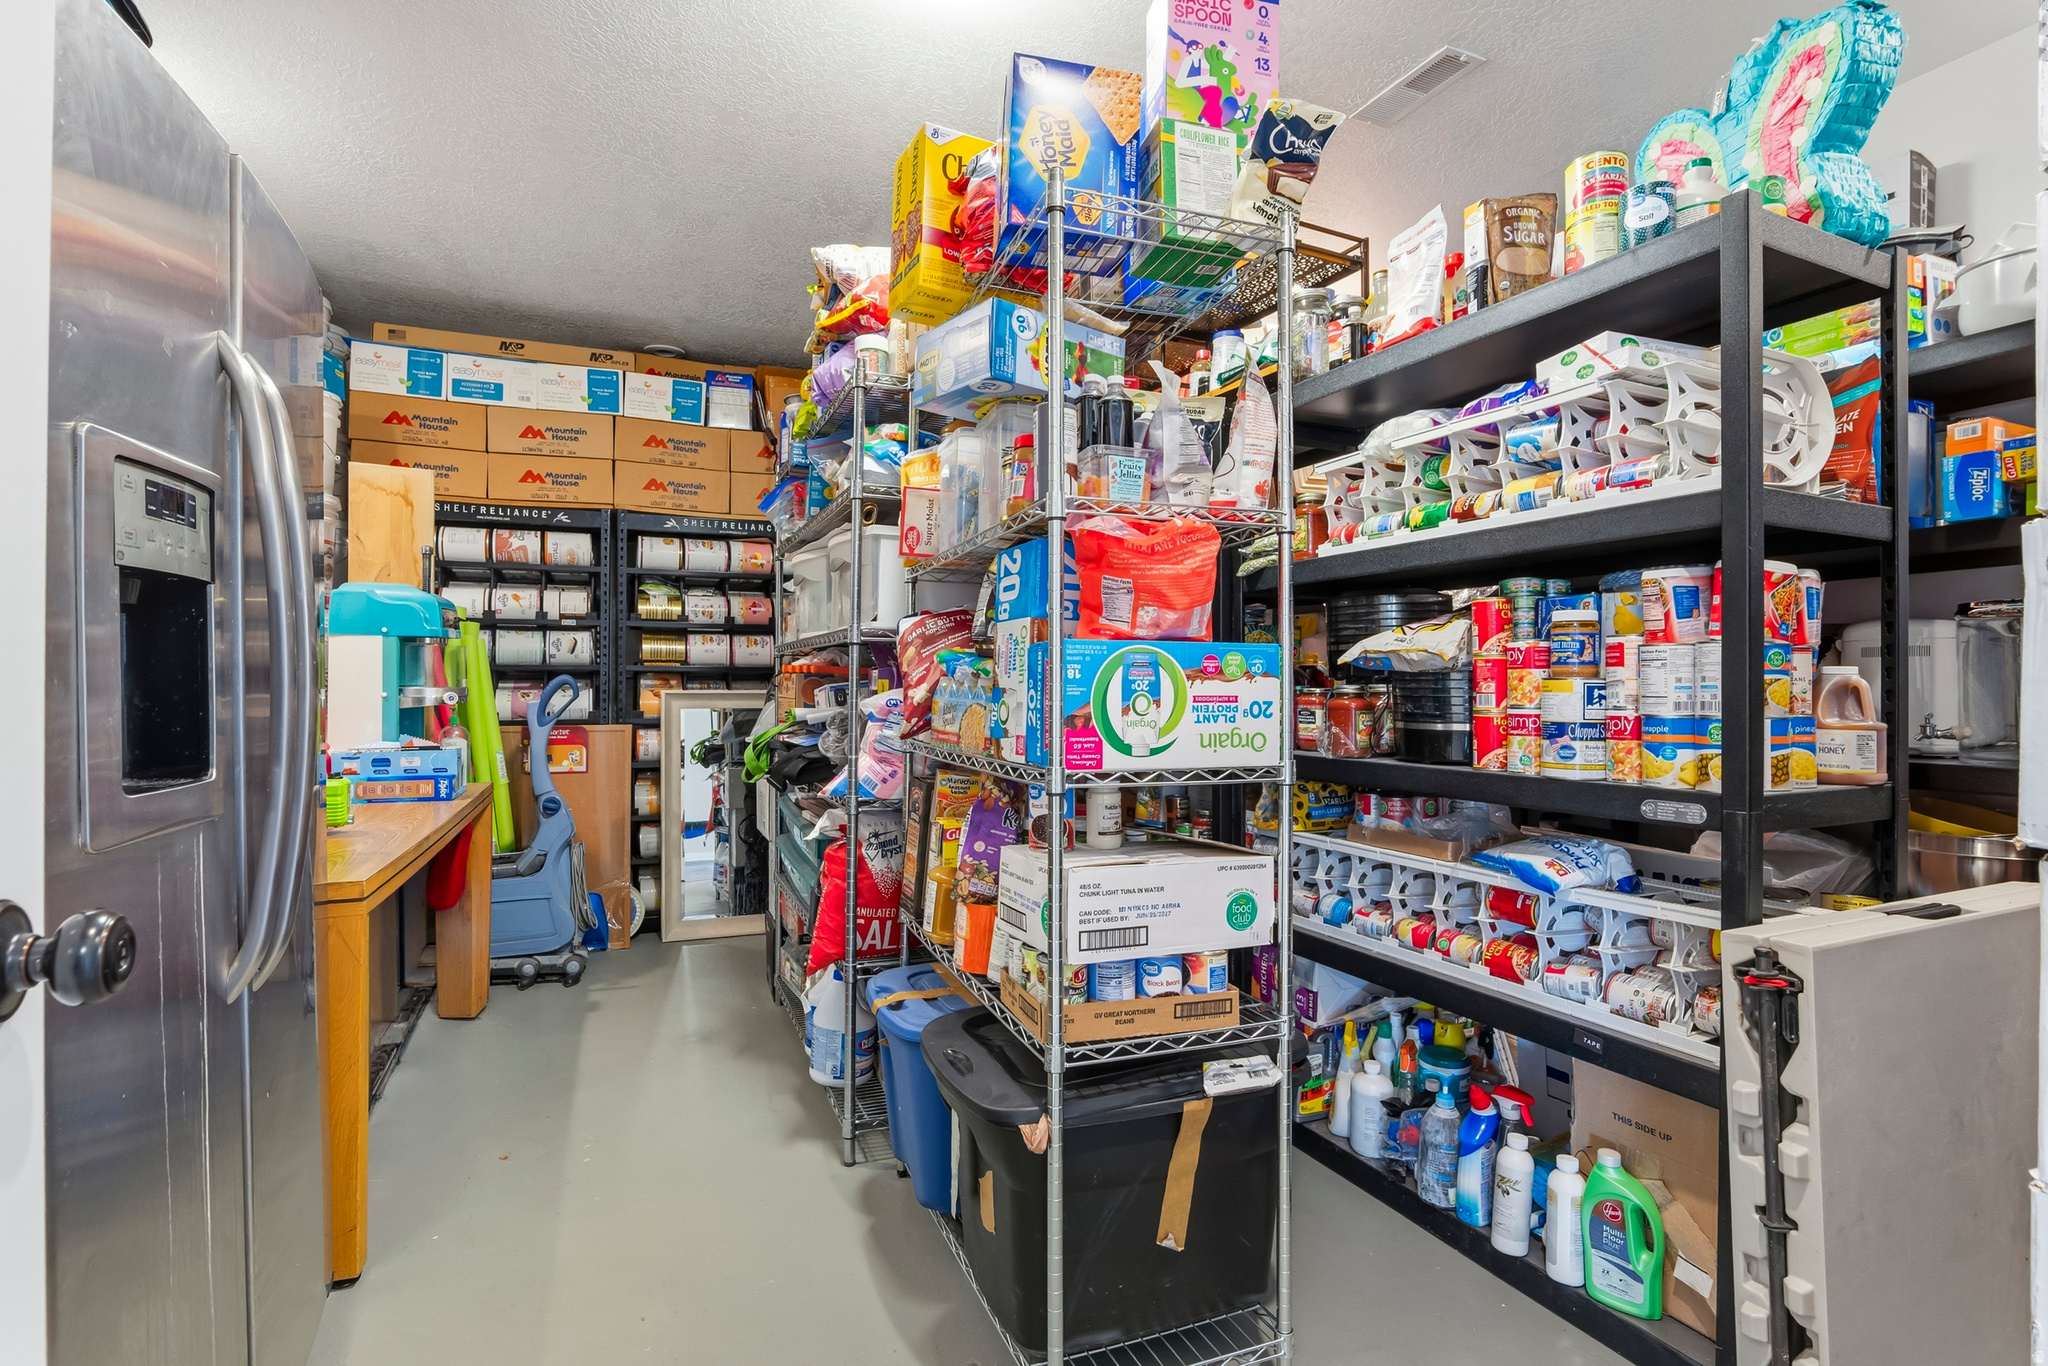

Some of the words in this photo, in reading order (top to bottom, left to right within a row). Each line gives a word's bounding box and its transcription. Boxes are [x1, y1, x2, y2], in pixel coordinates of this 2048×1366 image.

[1175, 4, 1231, 26] SPOON
[1210, 24, 1232, 32] CEREAL
[1037, 109, 1056, 174] Honey
[1057, 118, 1076, 167] Maid
[1180, 128, 1217, 145] CAULIFLOWER
[1218, 136, 1230, 147] RICE
[1586, 156, 1625, 171] CENTO
[910, 140, 920, 204] Cheerios
[894, 162, 903, 224] Cheerios
[1252, 202, 1278, 223] Lemon
[1505, 206, 1540, 220] ORGANIC
[1513, 221, 1538, 231] BROWN
[1504, 225, 1545, 245] SUGAR
[917, 290, 953, 303] Cheerios
[900, 307, 936, 319] Cheerios
[1016, 314, 1027, 333] 90
[499, 341, 525, 352] M&P
[355, 355, 401, 368] easymeal
[589, 352, 614, 363] M&P
[452, 365, 503, 378] easymeal
[541, 376, 583, 389] easymeal
[628, 386, 668, 398] easymeal
[411, 413, 458, 426] Mountain
[419, 422, 450, 432] House
[544, 426, 587, 436] Mountain
[552, 433, 580, 442] House
[666, 437, 706, 448] Mountain
[673, 445, 699, 454] House
[412, 461, 459, 473] Mountain
[1119, 460, 1143, 471] Fruity
[2004, 457, 2017, 479] GLAD
[544, 472, 587, 481] Mountain
[1118, 469, 1142, 480] Jellies
[552, 479, 580, 487] House
[666, 480, 706, 490] Mountain
[1971, 469, 1988, 502] Ziploc
[673, 488, 699, 496] House
[925, 498, 934, 522] Moist
[683, 519, 776, 532] SHELFRELIANC
[924, 522, 932, 546] Super
[1154, 540, 1174, 552] ARE
[908, 622, 935, 642] GARLIC
[936, 614, 973, 627] BUTTER
[925, 622, 955, 636] POPCORN
[1018, 625, 1028, 685] Orgain
[1067, 669, 1081, 679] 18
[1192, 704, 1239, 713] PROTEIN
[1243, 700, 1274, 719] 20g
[1126, 718, 1156, 729] Orgain
[1194, 714, 1237, 724] PLANT
[1568, 723, 1600, 742] Chopped
[1200, 726, 1267, 753] Orgain
[1818, 746, 1845, 755] HONEY
[947, 777, 979, 786] Maruchan
[1545, 860, 1568, 877] Dole
[1093, 908, 1112, 916] CODE:
[1232, 902, 1251, 914] food
[1079, 917, 1095, 925] BEST
[1233, 913, 1251, 924] club
[1261, 952, 1269, 996] KITCHEN
[1296, 994, 1304, 1006] 13
[1101, 1010, 1123, 1018] GREAT
[1124, 1008, 1156, 1017] NORTHERN
[1115, 1017, 1135, 1025] BEANS
[1583, 1036, 1601, 1050] TAPE
[1611, 1111, 1633, 1125] THIS
[1634, 1118, 1657, 1136] SIDE
[1659, 1130, 1673, 1142] UP
[1603, 1224, 1626, 1238] Multi-
[1603, 1231, 1625, 1246] Floor
[1602, 1267, 1610, 1275] 2X
